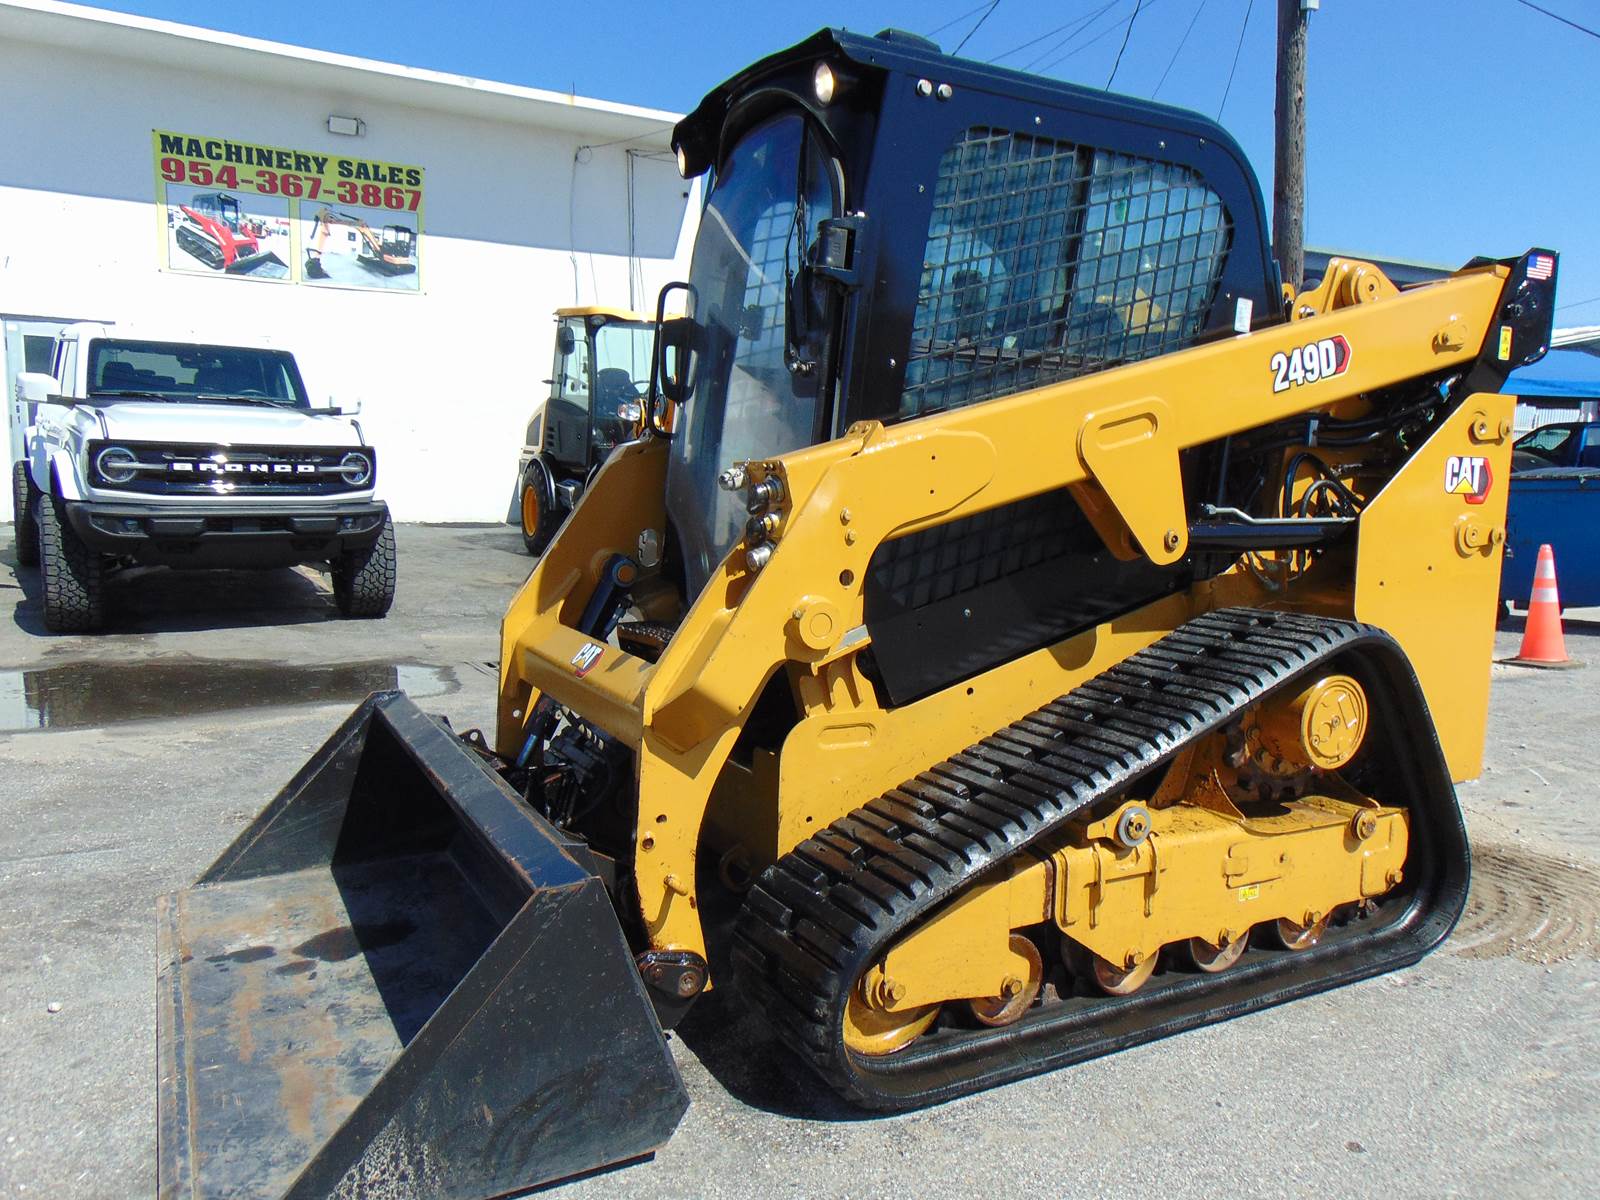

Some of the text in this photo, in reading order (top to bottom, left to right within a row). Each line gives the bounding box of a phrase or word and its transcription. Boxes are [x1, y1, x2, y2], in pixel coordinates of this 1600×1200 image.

[160, 133, 421, 186] MACHINERY SALES
[160, 157, 422, 212] 954-367-3867
[1270, 338, 1337, 394] 249D
[172, 462, 316, 474] BRONCO
[1445, 456, 1485, 495] CAT
[571, 642, 603, 670] CAT
